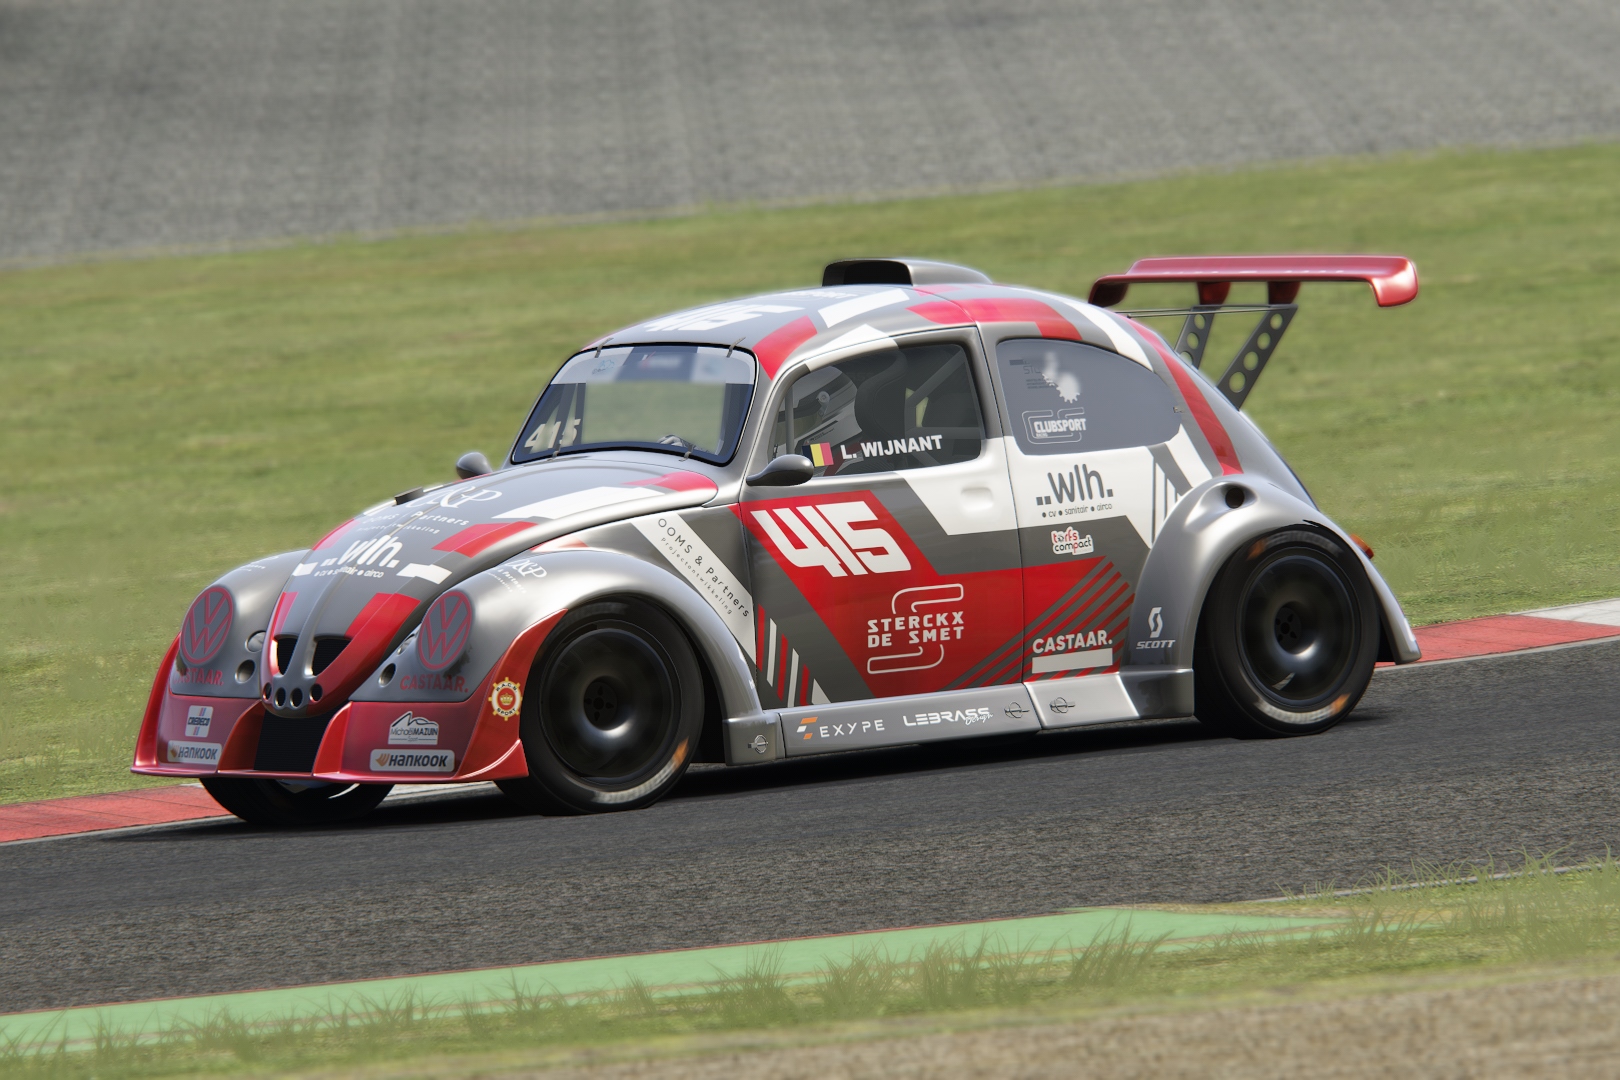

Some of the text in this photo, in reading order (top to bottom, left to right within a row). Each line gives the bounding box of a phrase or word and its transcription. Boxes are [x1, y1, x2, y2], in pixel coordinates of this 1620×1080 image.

[524, 418, 582, 454] 415
[1033, 418, 1087, 433] CLUBSPORT
[840, 434, 943, 460] L. WIJNANT
[1064, 505, 1089, 516] sanitair
[1096, 503, 1113, 511] airco
[750, 500, 912, 578] 415
[1053, 529, 1078, 543] torfs
[1054, 537, 1092, 553] compact
[658, 518, 750, 617] OOMS & Partners
[867, 611, 965, 634] STERCKX
[867, 626, 965, 648] DE SMET
[1032, 629, 1113, 654] CASTAAR.
[1136, 640, 1176, 650] SCOTT
[819, 707, 990, 738] EXYPE LEBRASS
